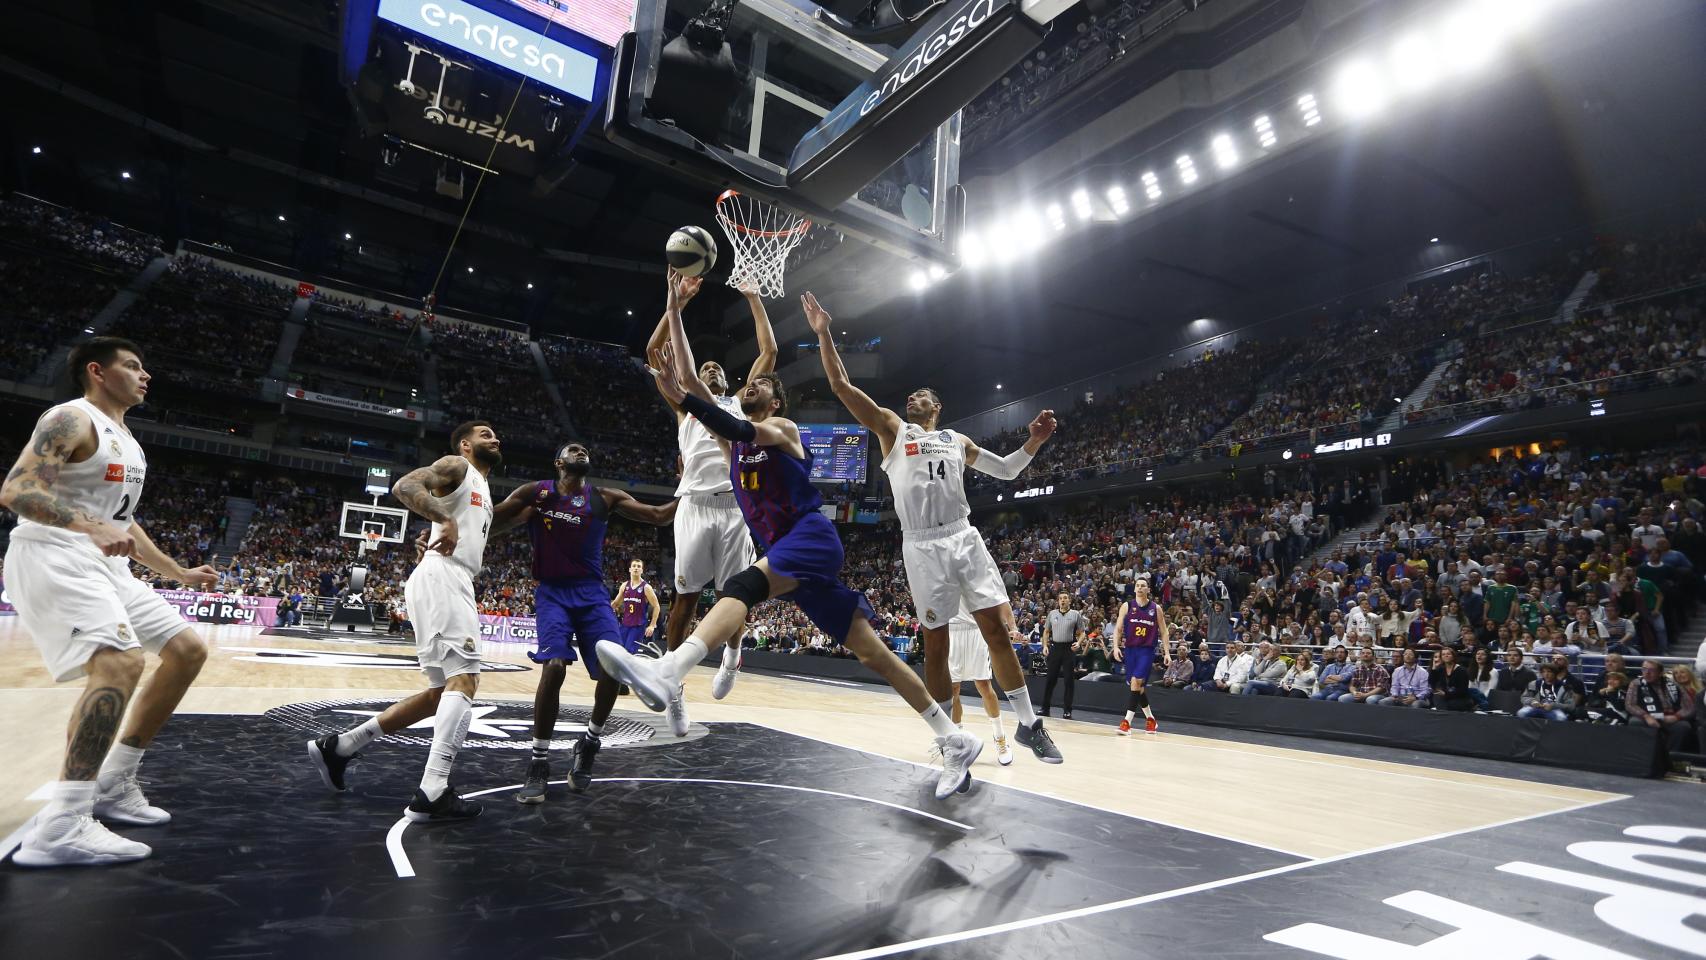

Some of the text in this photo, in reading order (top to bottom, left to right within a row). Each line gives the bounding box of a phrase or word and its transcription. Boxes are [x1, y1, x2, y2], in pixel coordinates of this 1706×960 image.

[420, 2, 565, 79] endesa
[859, 0, 994, 117] endesa
[424, 111, 535, 152] wizin
[315, 394, 359, 407] Comunidad
[845, 436, 860, 445] 92
[928, 459, 946, 481] 14
[112, 493, 130, 521] 2
[197, 595, 236, 605] principal
[237, 597, 249, 605] de
[250, 598, 259, 606] la
[629, 604, 634, 614] 3
[186, 602, 216, 617] del
[220, 604, 255, 623] Rey
[1135, 626, 1147, 637] 24
